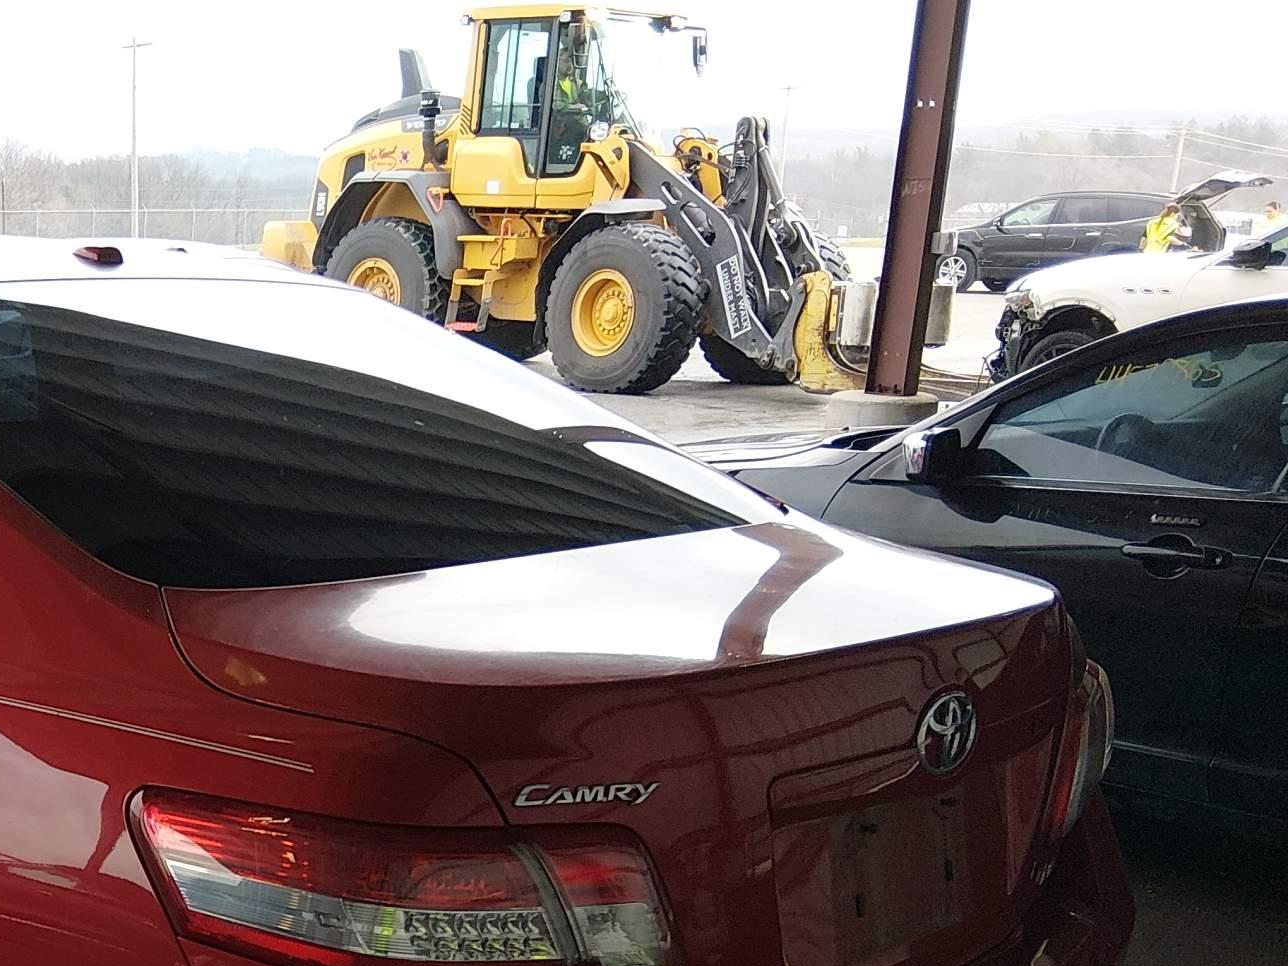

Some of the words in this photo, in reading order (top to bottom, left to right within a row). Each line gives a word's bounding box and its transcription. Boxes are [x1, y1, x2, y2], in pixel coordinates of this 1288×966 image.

[722, 268, 734, 303] UNDER
[729, 302, 740, 329] MAST
[729, 258, 737, 274] DO
[733, 276, 743, 298] NOT
[738, 299, 750, 329] WALK
[514, 782, 661, 807] CAMRY
